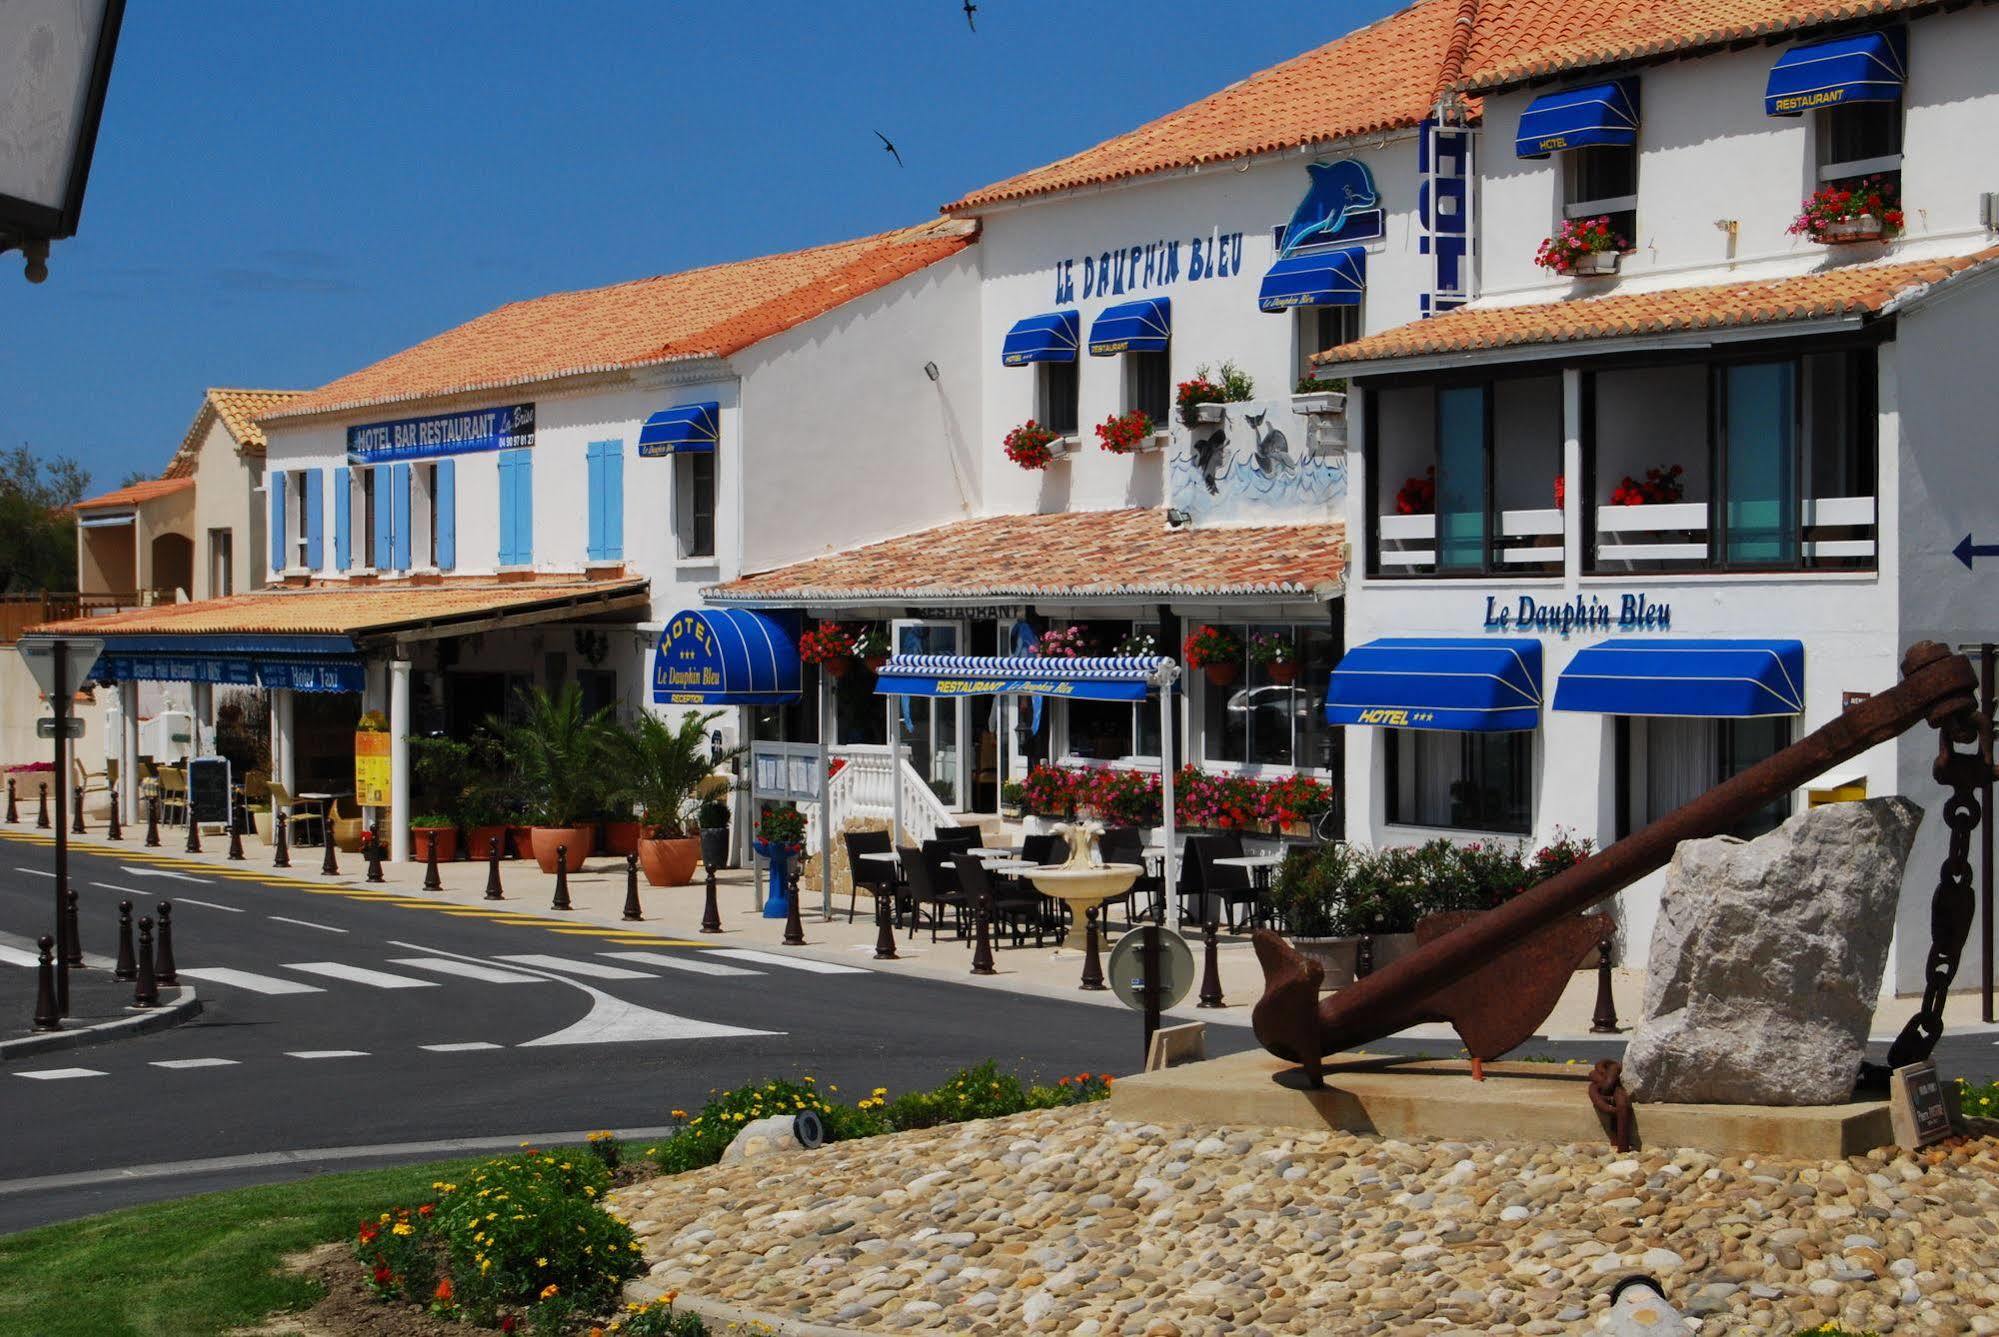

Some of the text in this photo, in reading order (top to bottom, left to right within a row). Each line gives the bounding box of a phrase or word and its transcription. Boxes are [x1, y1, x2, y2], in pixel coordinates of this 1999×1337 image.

[1776, 89, 1844, 111] RESTAURANT
[1540, 138, 1567, 150] HOTEL
[1056, 260, 1074, 305] LE
[1188, 232, 1243, 281] BLEU
[1091, 342, 1129, 354] RESTAURANT
[1006, 355, 1022, 363] HOTEL
[513, 406, 534, 428] Brise
[357, 413, 496, 452] HOTEL BAR RESTAURANT
[499, 437, 506, 448] 04
[527, 433, 535, 445] 27
[1483, 592, 1672, 636] Le Dauphin Bleu
[661, 617, 712, 657] HOTEL
[657, 667, 720, 689] Le Dauphin Bleu
[935, 680, 1006, 693] RESTAURANT
[671, 694, 704, 703] RECEPTION
[1358, 709, 1409, 726] HOTEL
